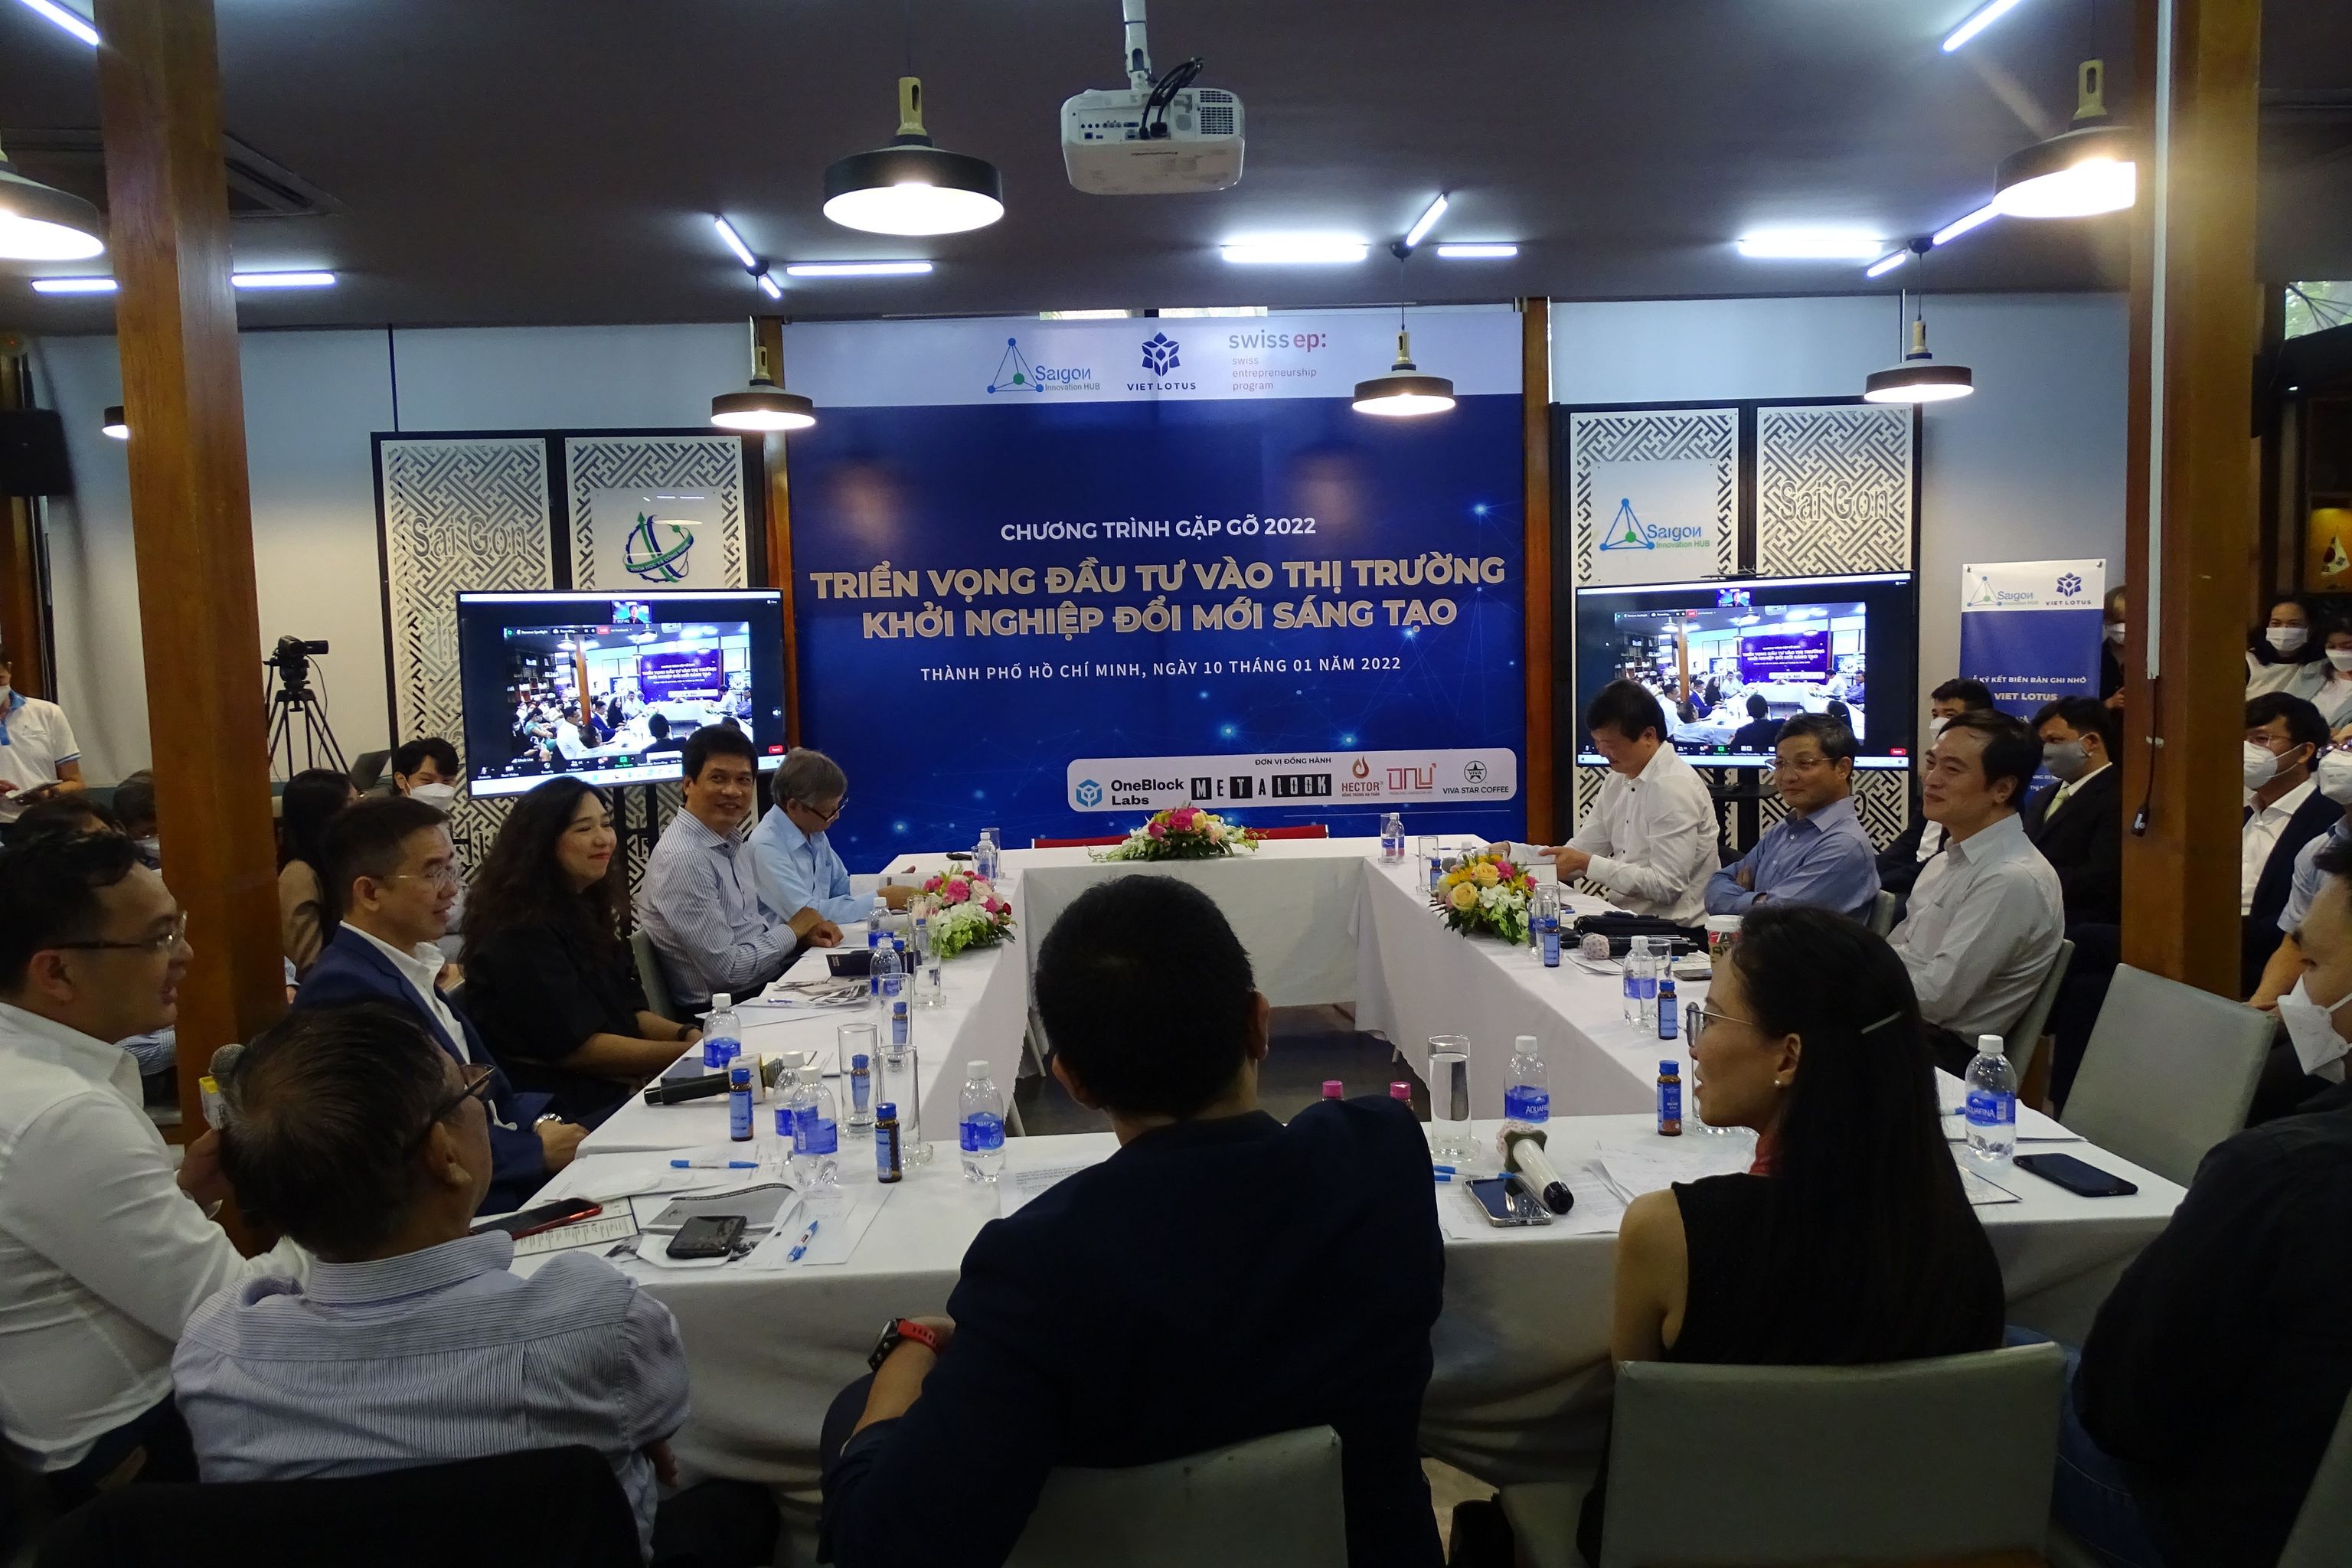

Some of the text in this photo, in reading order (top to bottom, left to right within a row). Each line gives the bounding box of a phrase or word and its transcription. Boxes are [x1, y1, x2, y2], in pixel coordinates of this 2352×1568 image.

[1229, 329, 1326, 352] swiss ep:
[1232, 356, 1259, 365] swiss
[1232, 368, 1317, 379] entrepreneurship
[1045, 382, 1100, 391] Innovation HUB
[1233, 382, 1273, 392] program
[1001, 514, 1315, 541] CHƯƠNG TRÌNH GẶP GỠ 2022
[810, 551, 1505, 603] TRIỂN VỌNG ĐẦU TƯ VÀO THỊ TRƯỜNG
[862, 595, 1457, 642] KHỞI NGHIỆP ĐỔI MỚI SÁNG TẠO
[921, 655, 1401, 681] THÀNH PHỐ HỒ CHÍ MINH, NGÀY 10 THÁNG 01 NĂM 2022
[1991, 675, 2006, 683] KẾT
[2021, 692, 2058, 701] LOTUS
[1284, 756, 1307, 765] ĐỒNG
[1309, 756, 1331, 765] HÀNH
[1111, 778, 1185, 792] OneBlock
[1112, 795, 1150, 805] Labs
